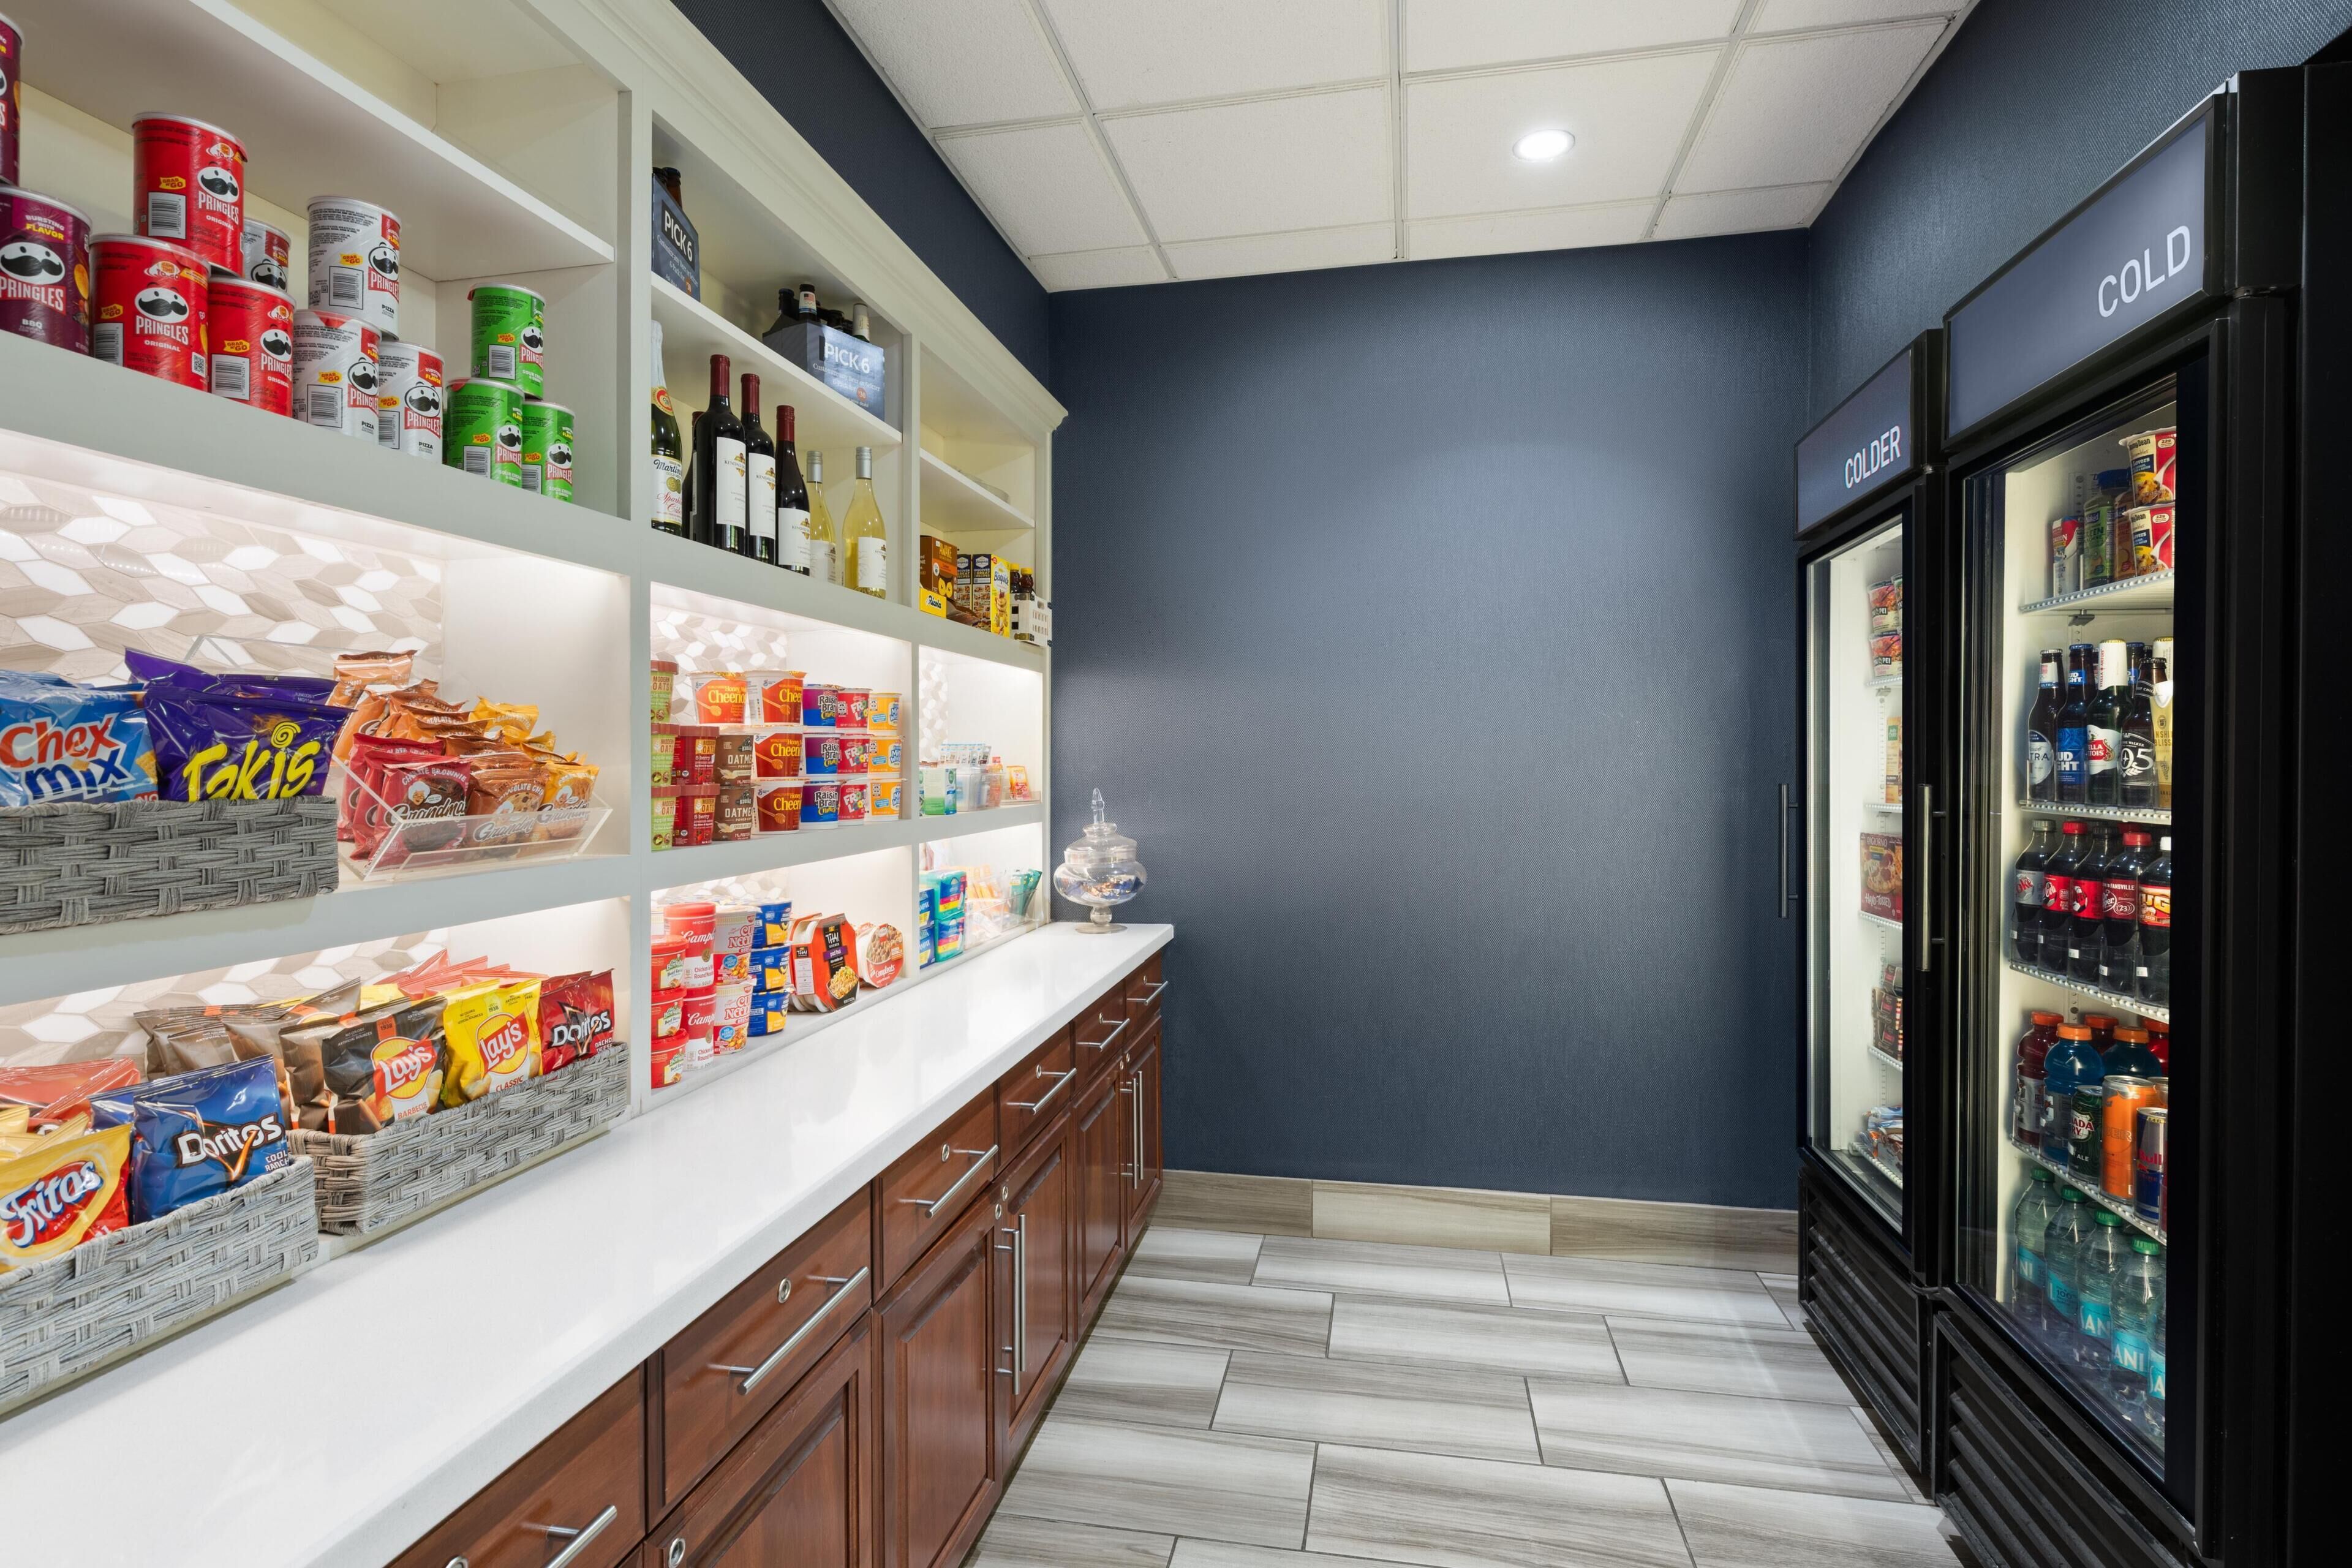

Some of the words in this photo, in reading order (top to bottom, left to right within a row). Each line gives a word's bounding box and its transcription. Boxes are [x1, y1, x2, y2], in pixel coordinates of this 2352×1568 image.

[198, 190, 239, 225] PRINGLES
[25, 214, 64, 232] BURSTING
[26, 223, 64, 240] FLAVOR
[206, 215, 235, 230] ORIGINAL
[665, 209, 687, 255] PICK
[687, 241, 693, 262] 6
[2097, 224, 2191, 319] COLD
[382, 304, 395, 314] PIZZA
[21, 318, 43, 330] BBQ
[135, 315, 189, 345] PRINGLES
[144, 340, 181, 352] ORIGINAL
[260, 353, 293, 382] PRINGLES
[824, 342, 859, 371] PICK
[861, 358, 870, 374] 6
[361, 421, 374, 430] PIZZA
[418, 441, 434, 450] PIZZA
[1844, 424, 1901, 490] COLDER
[928, 595, 942, 609] Ricola
[652, 682, 670, 691] OATS
[851, 700, 867, 714] FRO
[0, 717, 119, 769] Chex
[183, 721, 322, 802] Takis
[2030, 752, 2050, 761] TRA
[2057, 752, 2073, 761] UD
[2120, 747, 2154, 771] 05
[24, 749, 128, 801] mix
[431, 767, 467, 783] BROWNIE
[815, 791, 838, 801] Raisin
[2139, 893, 2170, 915] UG
[825, 932, 840, 945] THAI
[551, 1011, 612, 1047] Doritos
[480, 1020, 522, 1069] Lay's
[595, 1037, 612, 1048] NACHO
[383, 1044, 434, 1091] Lay's
[496, 1074, 524, 1093] CLASSIC
[398, 1100, 428, 1120] BARBECUE
[179, 1115, 284, 1165] Doritos
[265, 1151, 288, 1164] COOL
[0, 1161, 104, 1248] Fritos
[2113, 1346, 2144, 1373] ANI
